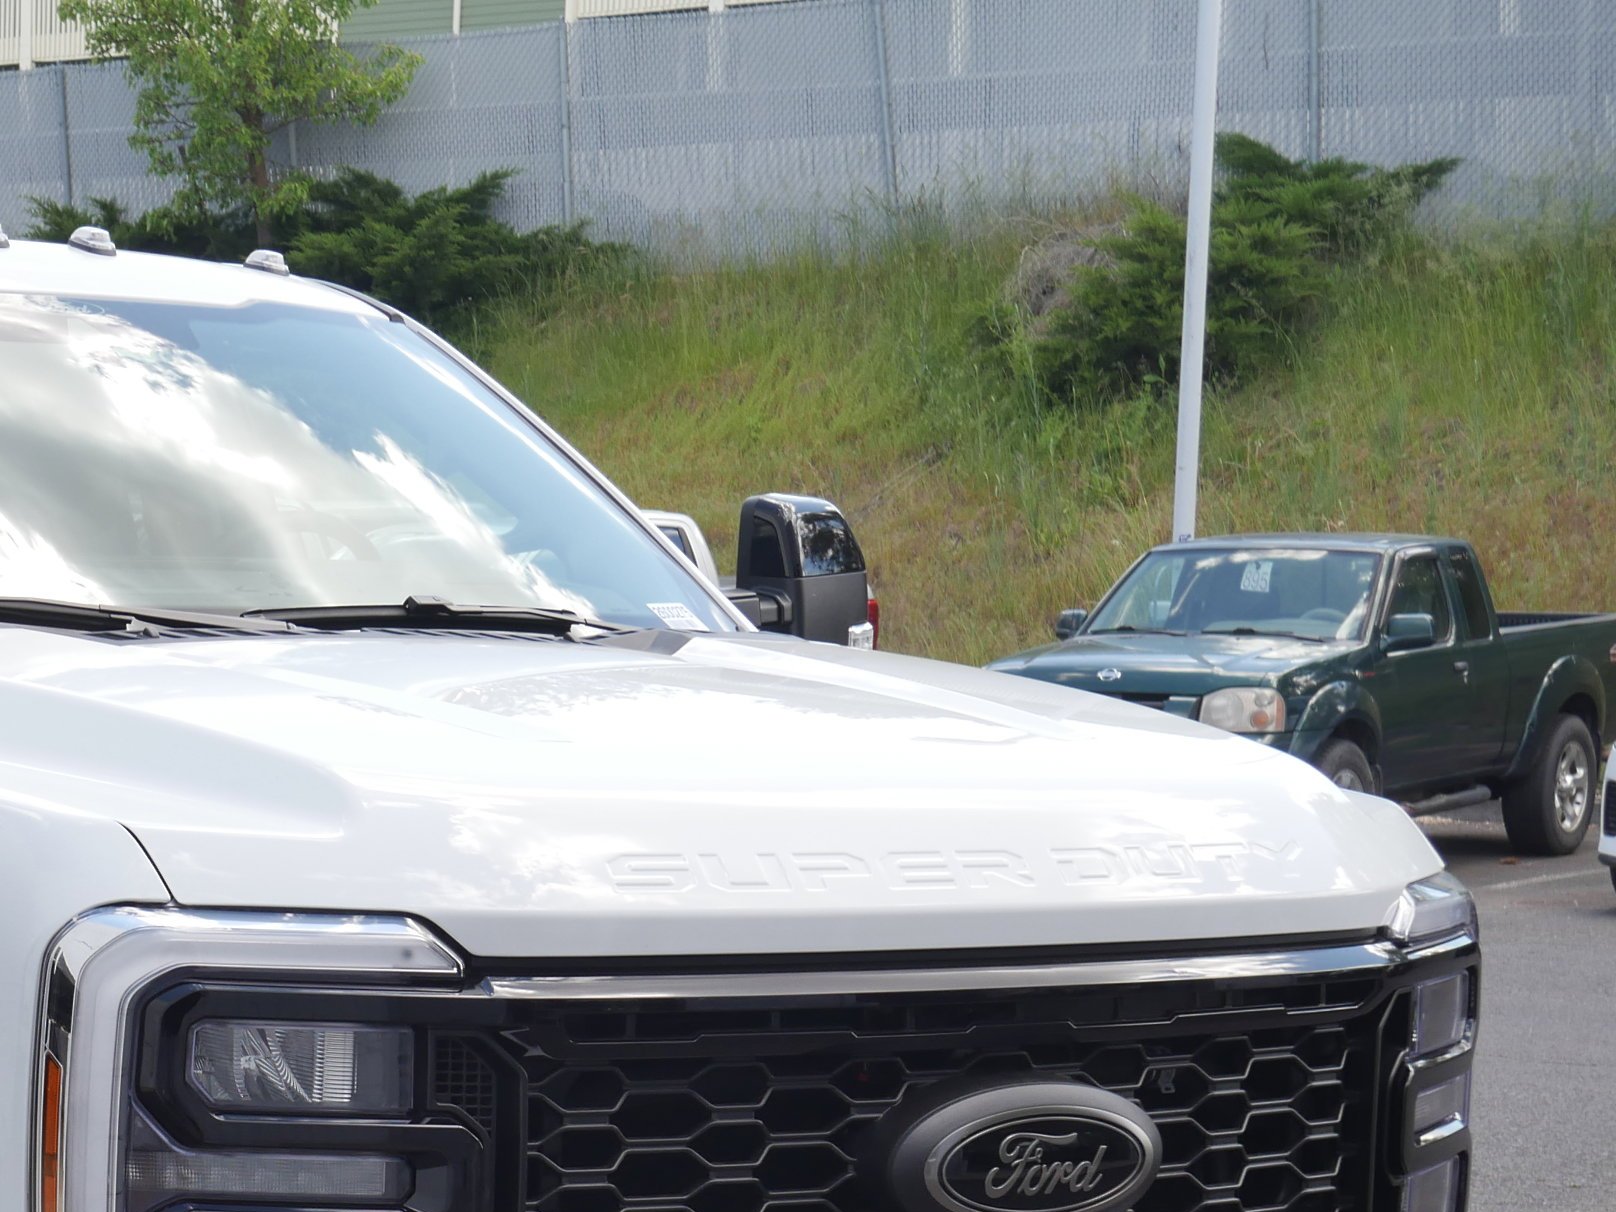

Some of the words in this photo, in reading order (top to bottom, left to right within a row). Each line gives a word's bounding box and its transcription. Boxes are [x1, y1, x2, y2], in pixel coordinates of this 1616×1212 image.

[605, 850, 1036, 893] SUPER
[1048, 841, 1304, 887] DUTY
[985, 1132, 1107, 1199] Ford
